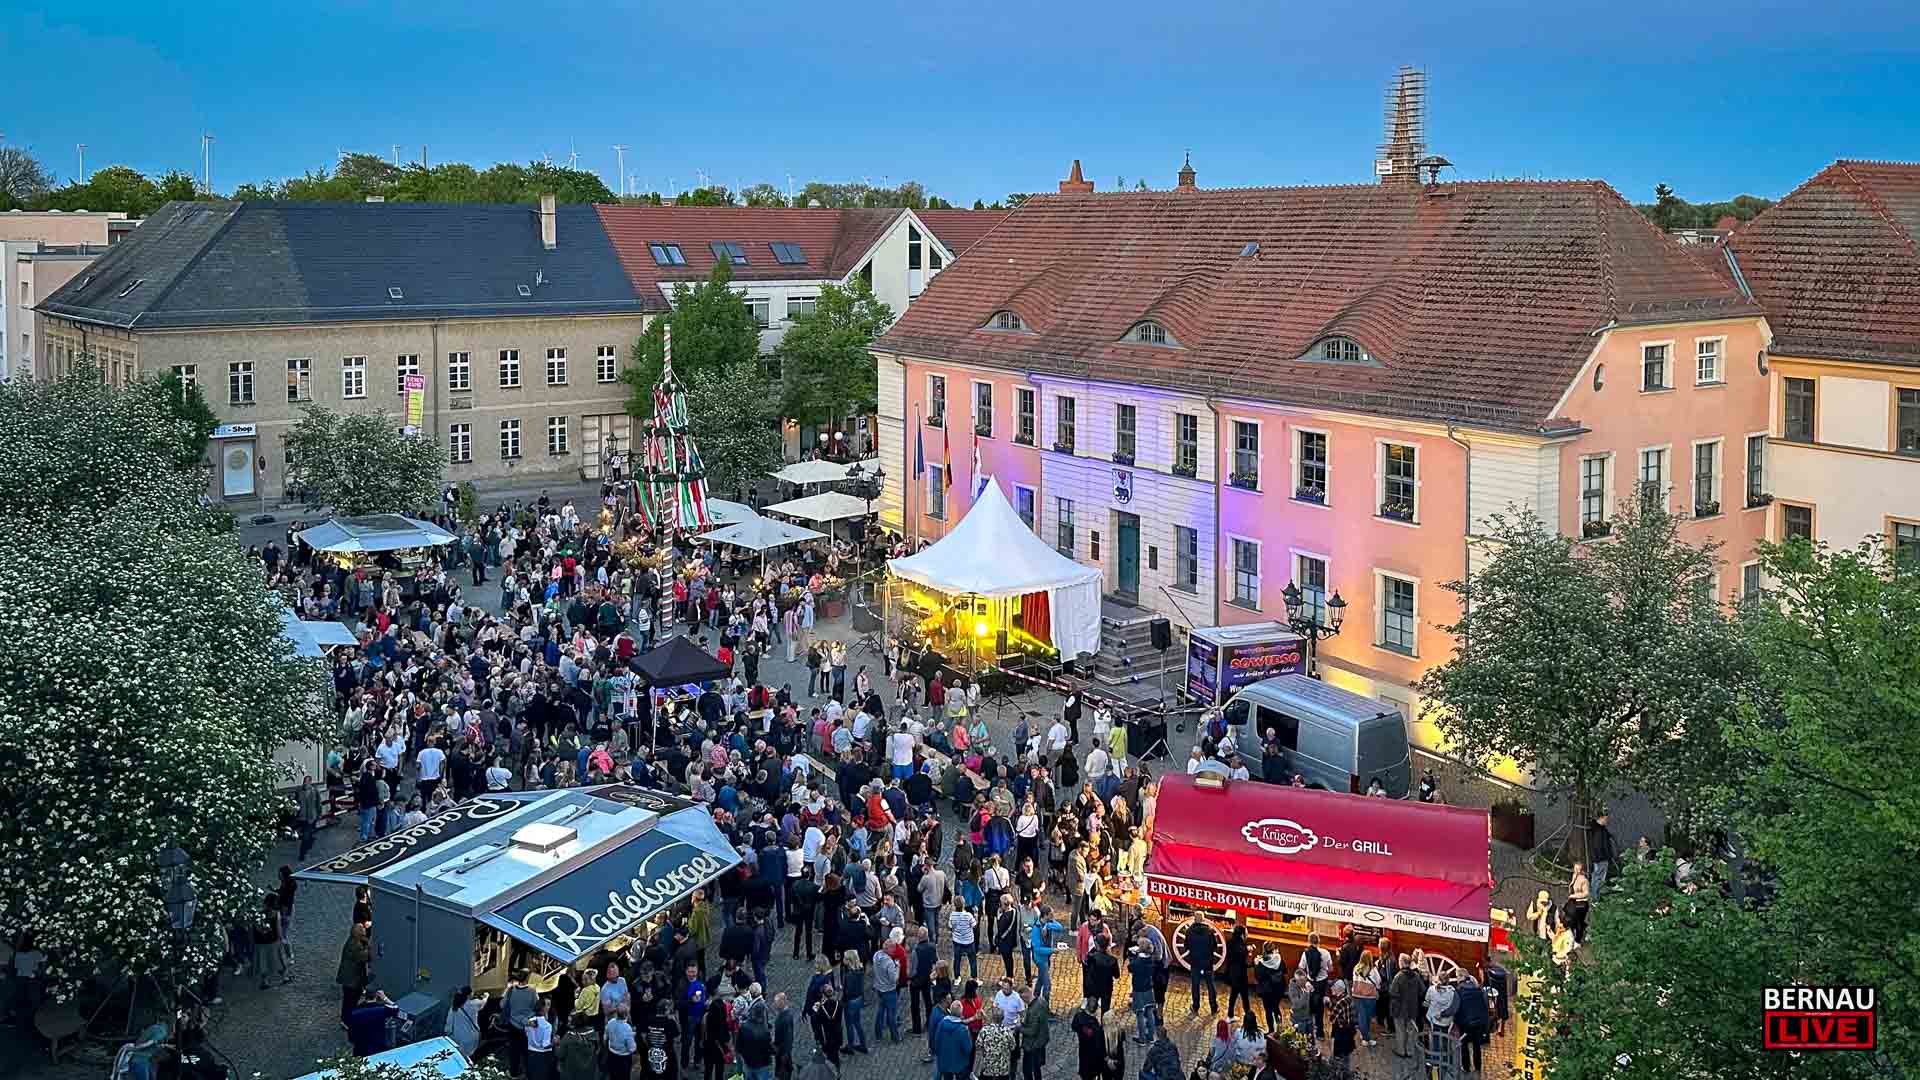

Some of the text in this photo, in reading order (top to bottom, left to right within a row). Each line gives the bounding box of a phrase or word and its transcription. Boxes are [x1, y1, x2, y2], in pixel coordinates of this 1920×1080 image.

[1262, 827, 1299, 846] Krüger
[1323, 836, 1393, 856] Der GRILL
[521, 841, 721, 955] Radeberger
[1150, 881, 1267, 912] ERDBEER-BOWLE
[1269, 895, 1355, 918] Thüringer Bratwurst
[1393, 914, 1485, 938] Thüringer Bratwurst
